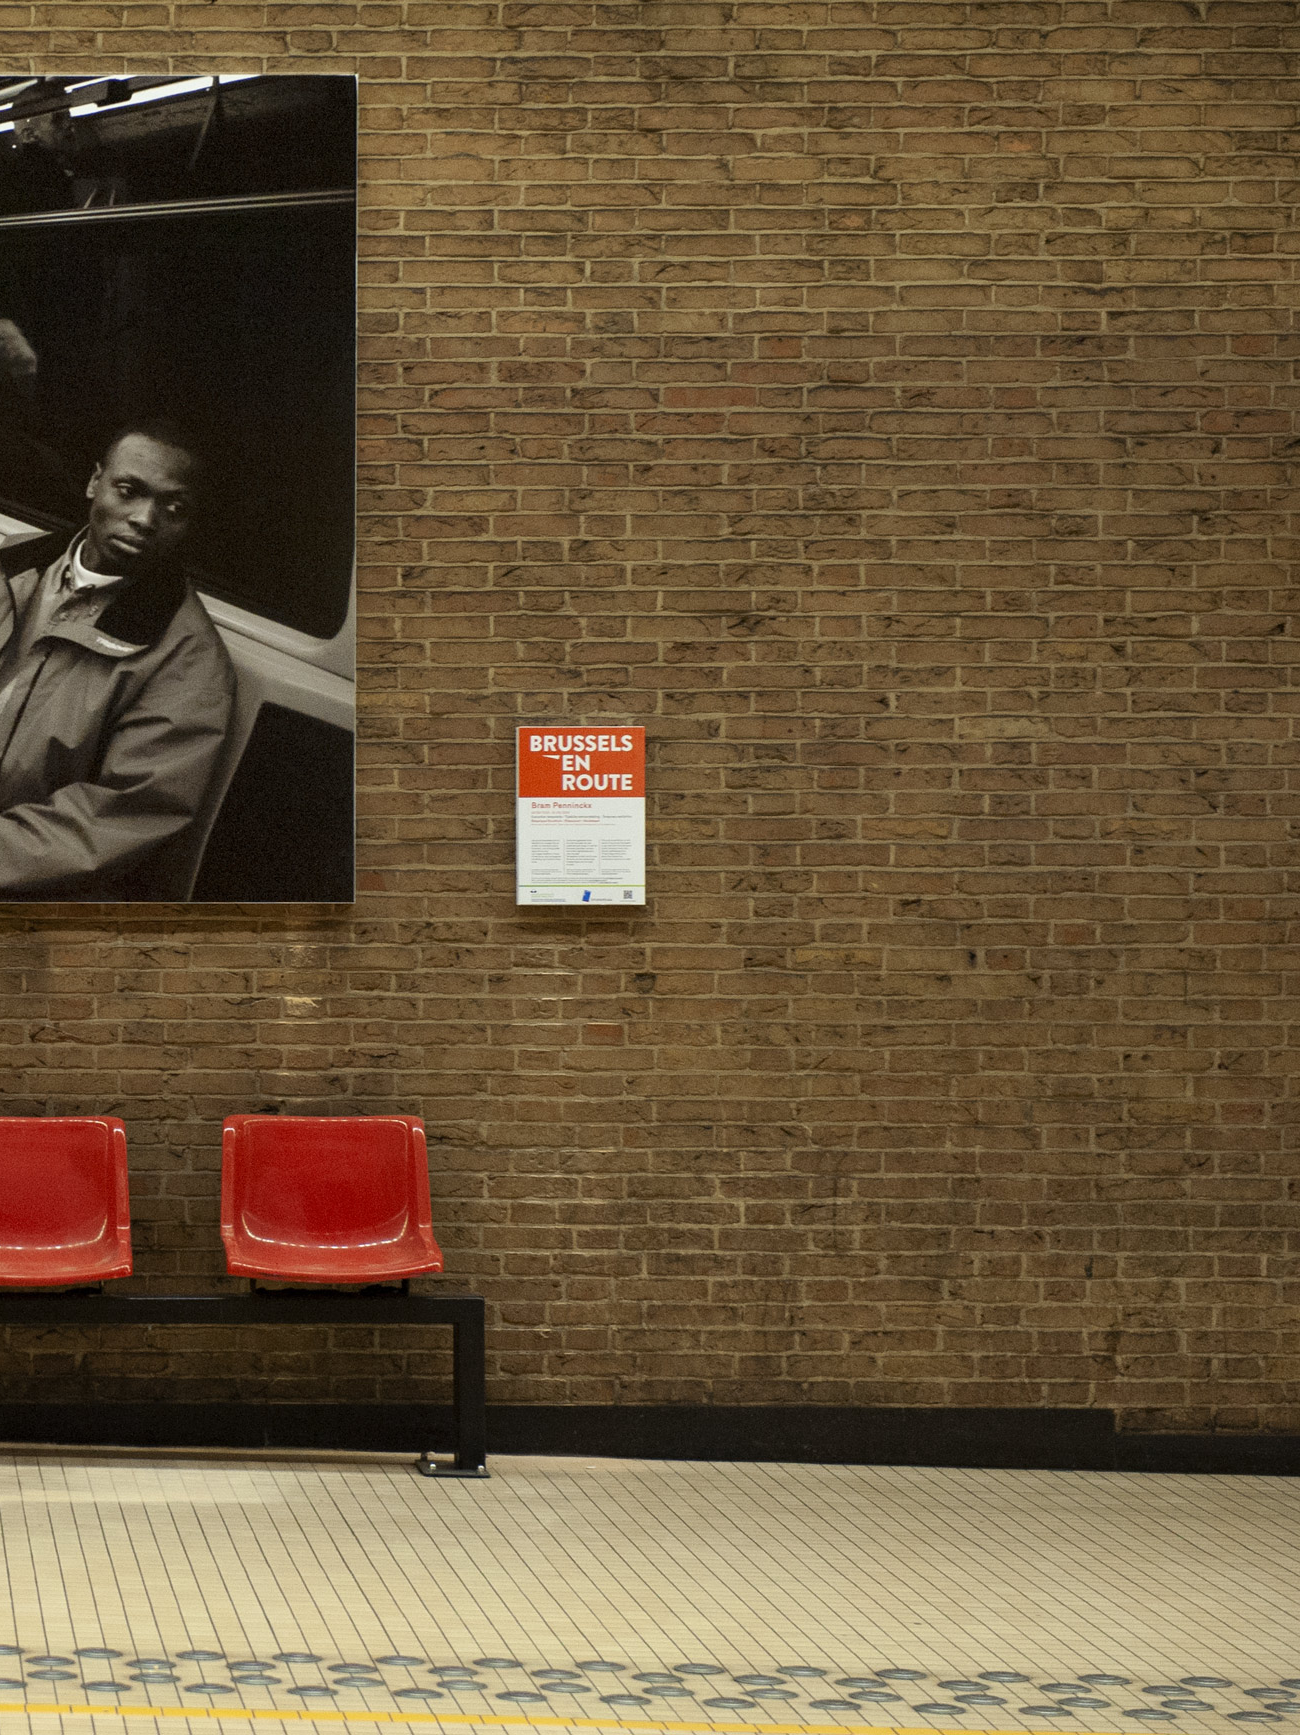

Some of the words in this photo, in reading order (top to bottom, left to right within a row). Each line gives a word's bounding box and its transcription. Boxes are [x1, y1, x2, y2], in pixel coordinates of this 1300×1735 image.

[529, 734, 634, 752] BRUSSELS
[562, 754, 591, 771] EN
[562, 773, 634, 791] ROUTE
[531, 801, 551, 809] Bram
[552, 801, 593, 809] Penninckx
